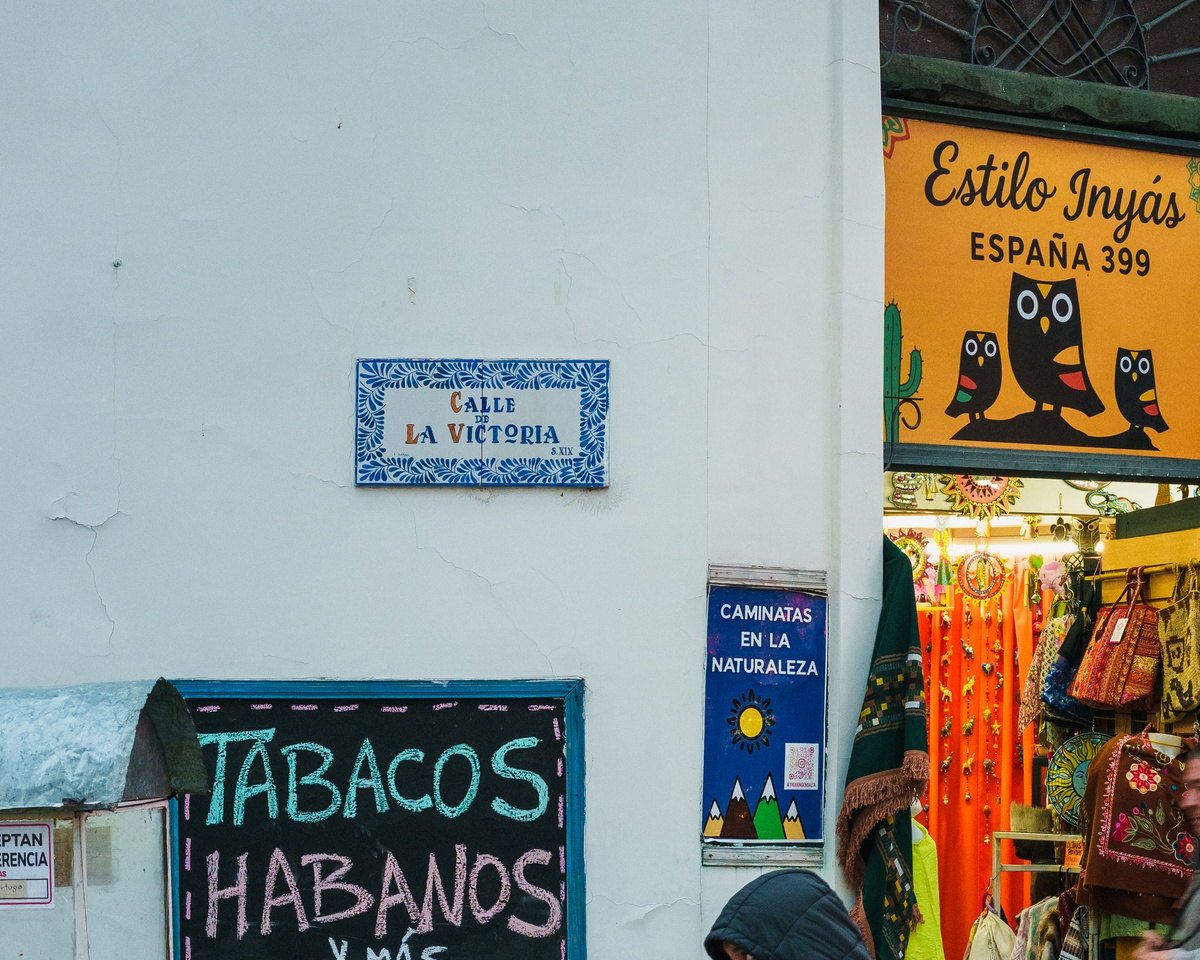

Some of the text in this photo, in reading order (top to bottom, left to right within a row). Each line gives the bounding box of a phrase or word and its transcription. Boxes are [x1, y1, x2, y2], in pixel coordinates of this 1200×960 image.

[924, 140, 1186, 244] Estilo Inyás
[970, 231, 1151, 277] ESPAÑA 399
[720, 603, 813, 624] CAMINATAS
[740, 631, 791, 649] EN LA
[711, 657, 819, 676] NATURALEZA
[196, 727, 550, 826] TABACOS
[204, 843, 564, 940] HABANOS
